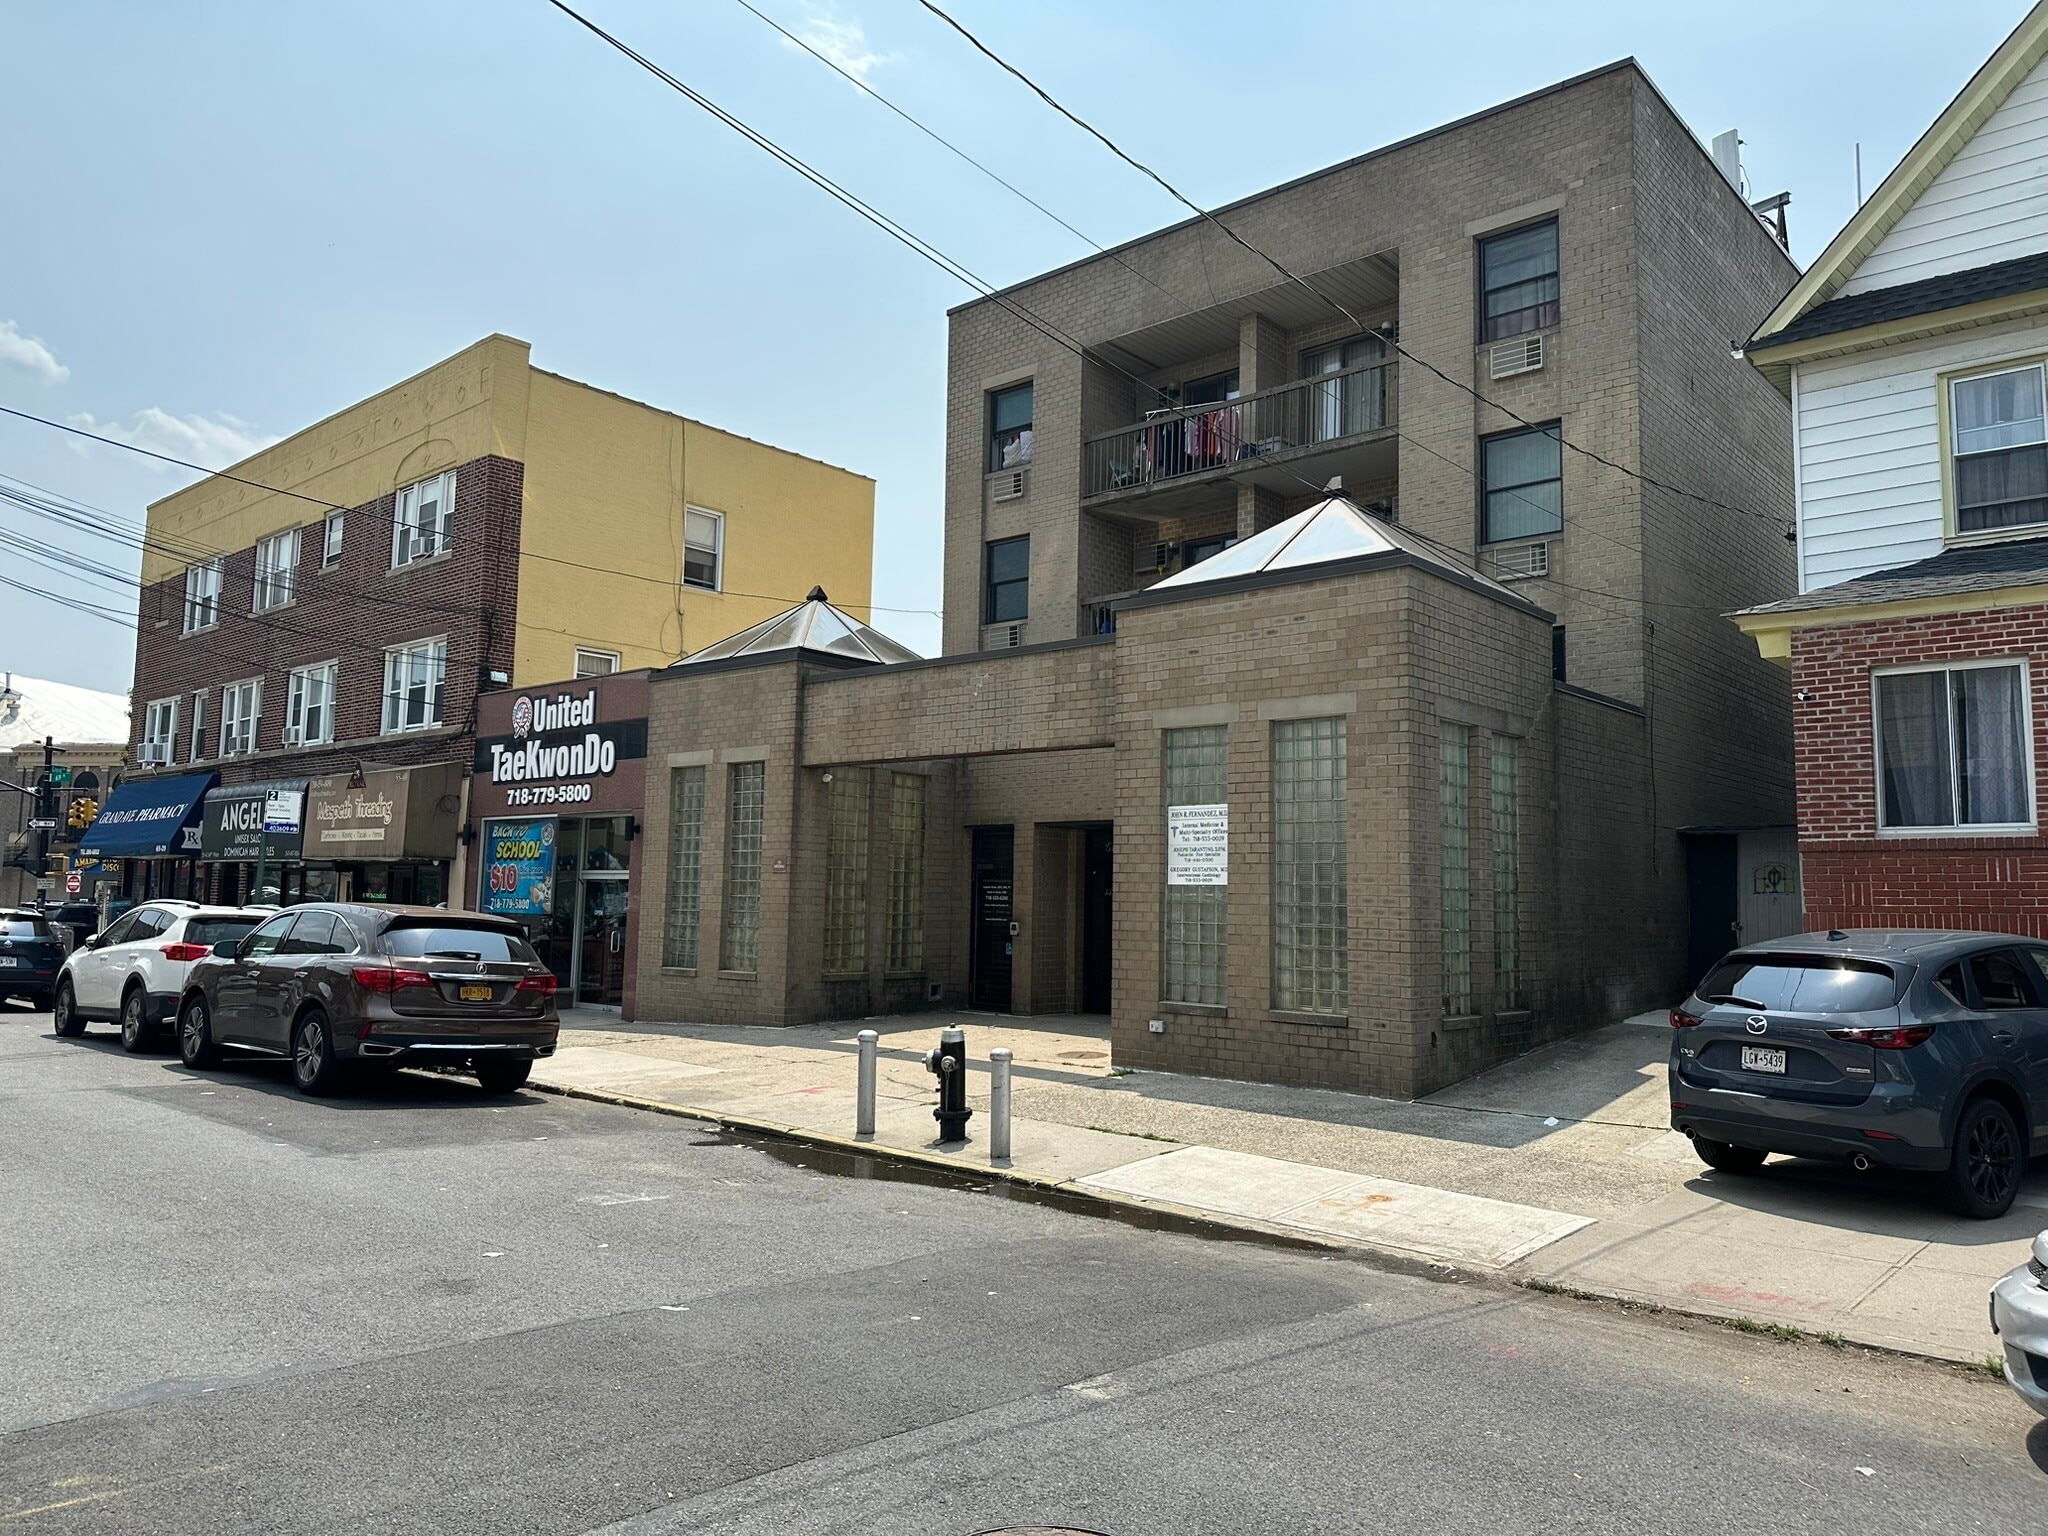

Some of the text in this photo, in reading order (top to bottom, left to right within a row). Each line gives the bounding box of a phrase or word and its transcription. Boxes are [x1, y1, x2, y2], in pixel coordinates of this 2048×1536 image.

[533, 690, 595, 733] United
[490, 733, 616, 783] TaeKwonDo
[269, 791, 276, 800] 2
[507, 784, 592, 806] 718-779-5800
[134, 803, 189, 822] PHARMACY
[317, 791, 393, 828] Maspeth Threading
[1171, 811, 1183, 819] JOHN
[234, 833, 250, 844] UNISEX
[492, 825, 515, 838] BACK
[514, 825, 529, 838] TO
[223, 847, 248, 857] DOMINICAN
[249, 847, 260, 857] HAIR
[496, 840, 541, 859] SCHOOL
[490, 862, 519, 893] $10
[490, 897, 531, 909] 718-779-5800
[1764, 1054, 1783, 1068] 5439
